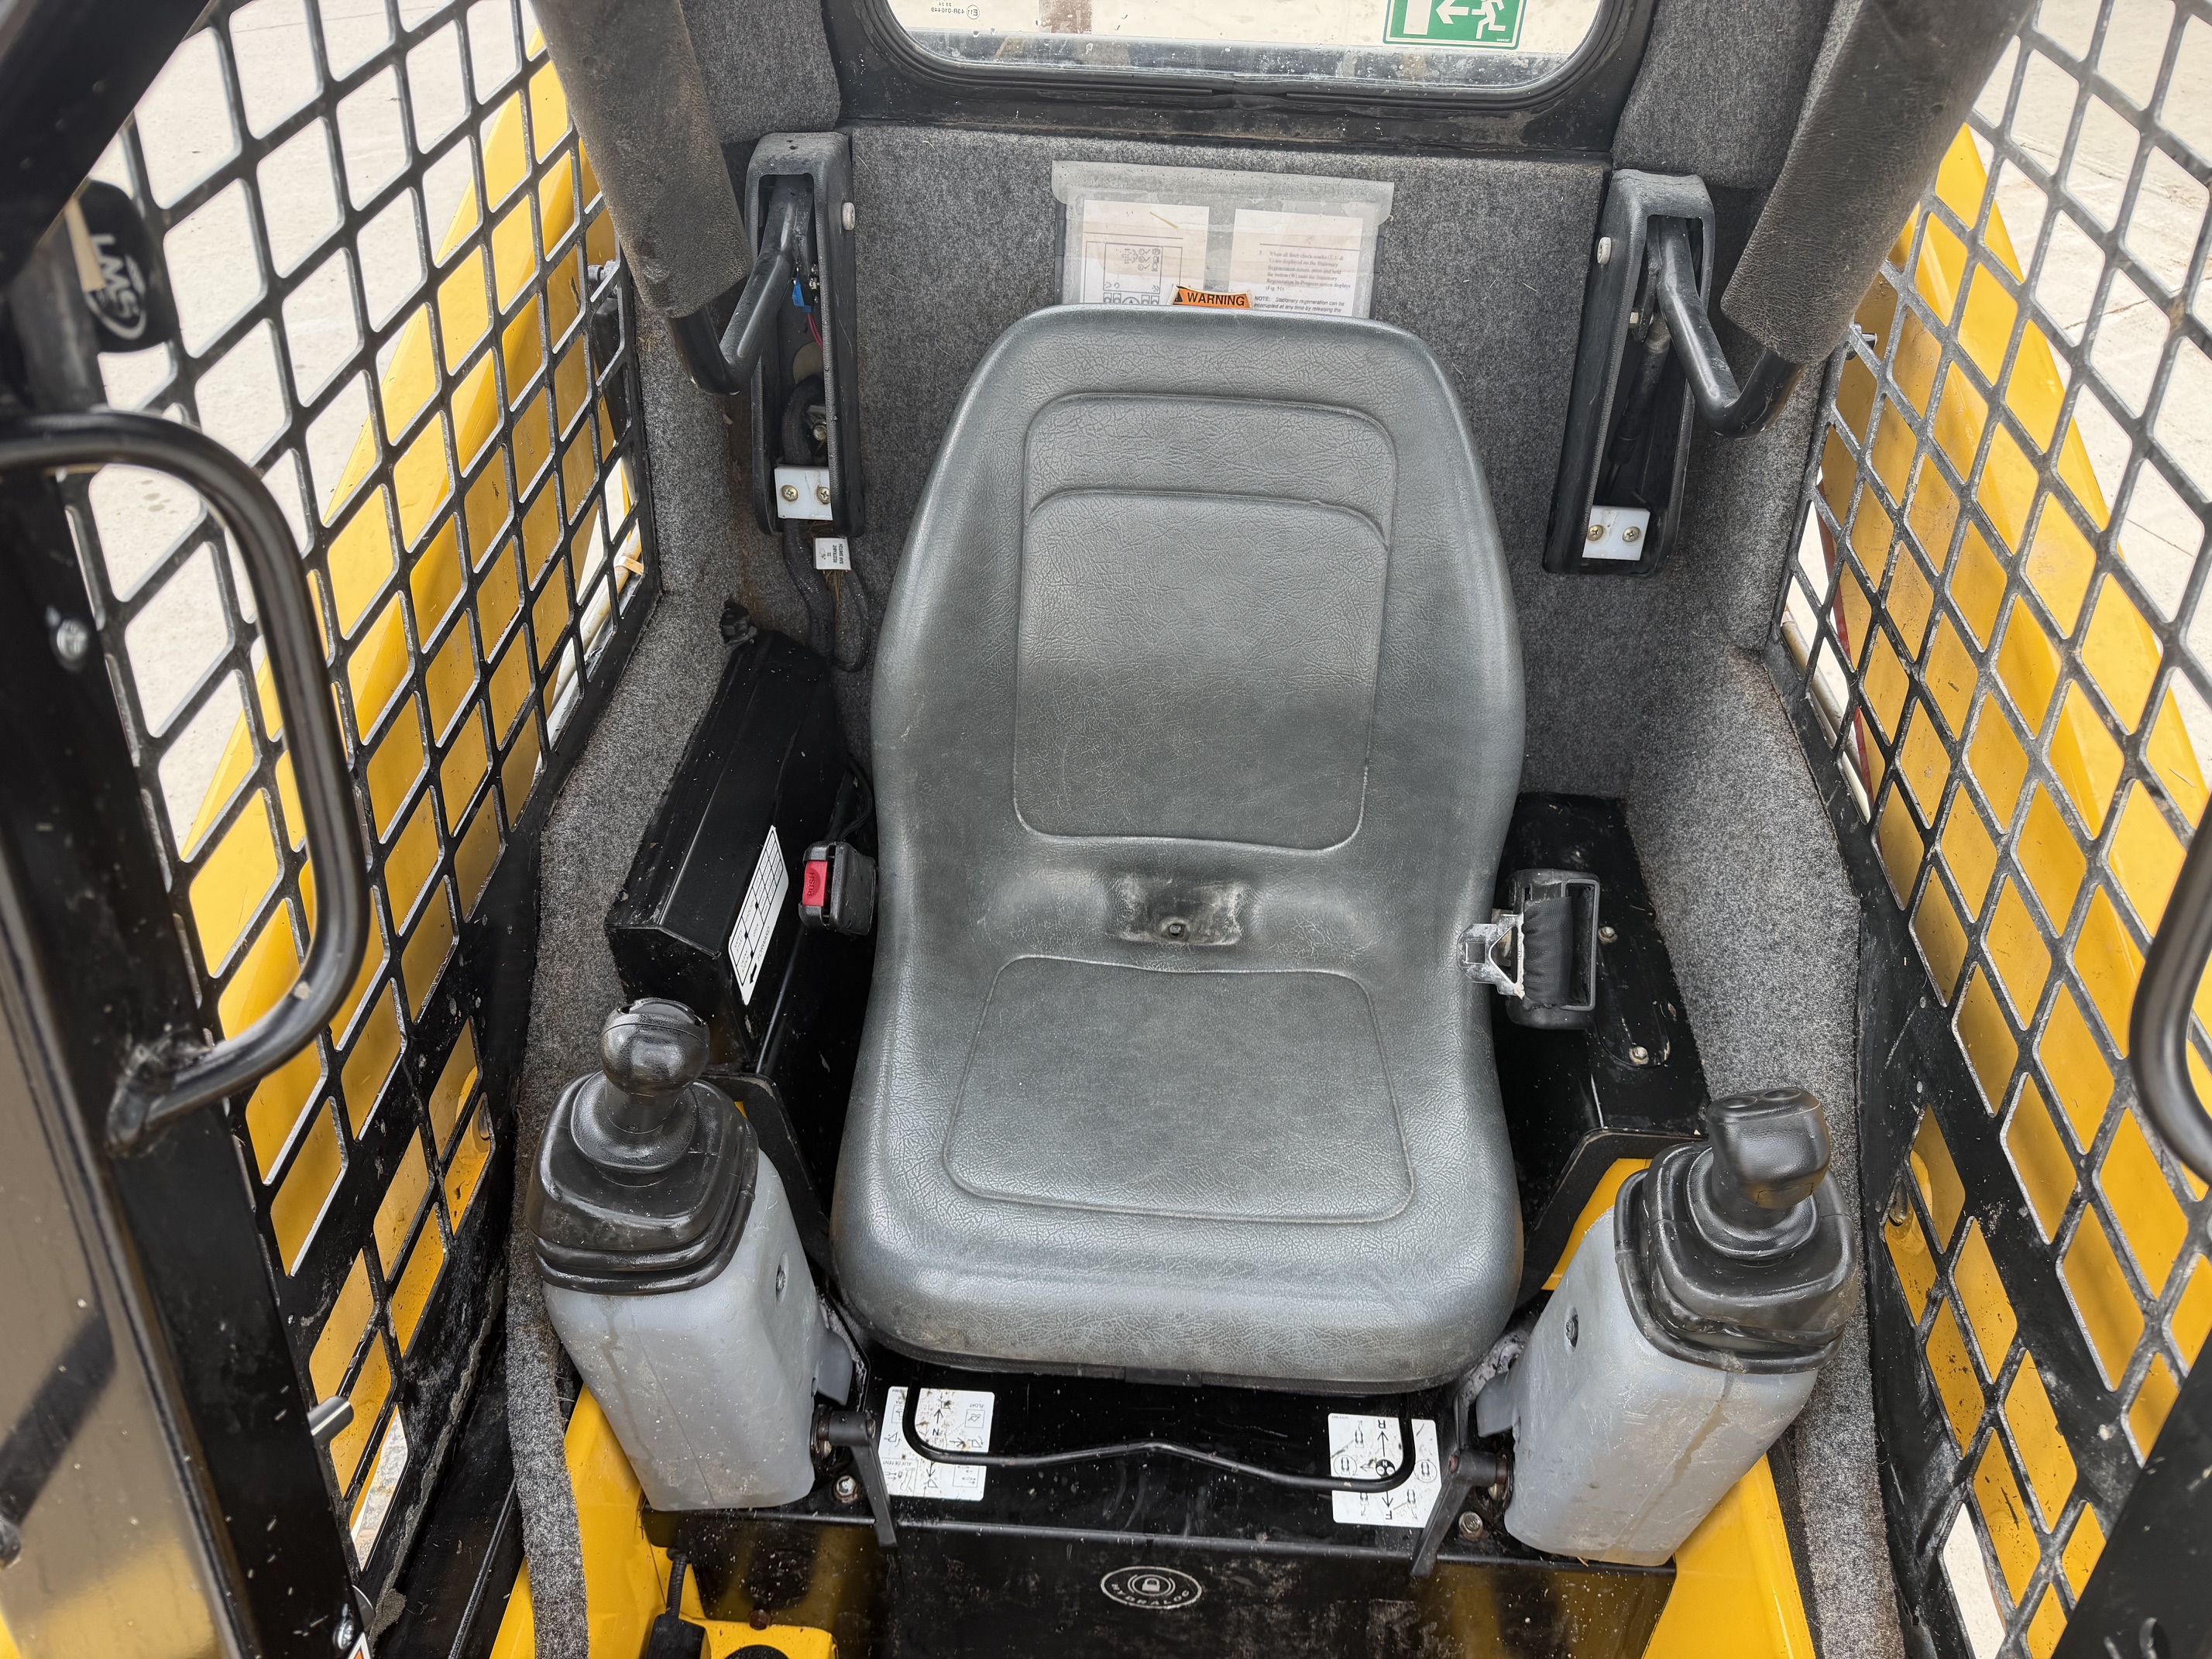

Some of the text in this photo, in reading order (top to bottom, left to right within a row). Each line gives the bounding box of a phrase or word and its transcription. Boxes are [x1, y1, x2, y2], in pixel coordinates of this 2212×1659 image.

[1187, 292, 1245, 306] WARNING
[757, 926, 770, 961] FORWARD
[1378, 1419, 1386, 1429] R
[1386, 1510, 1393, 1520] F
[1111, 1583, 1190, 1606] HYDRALOC
